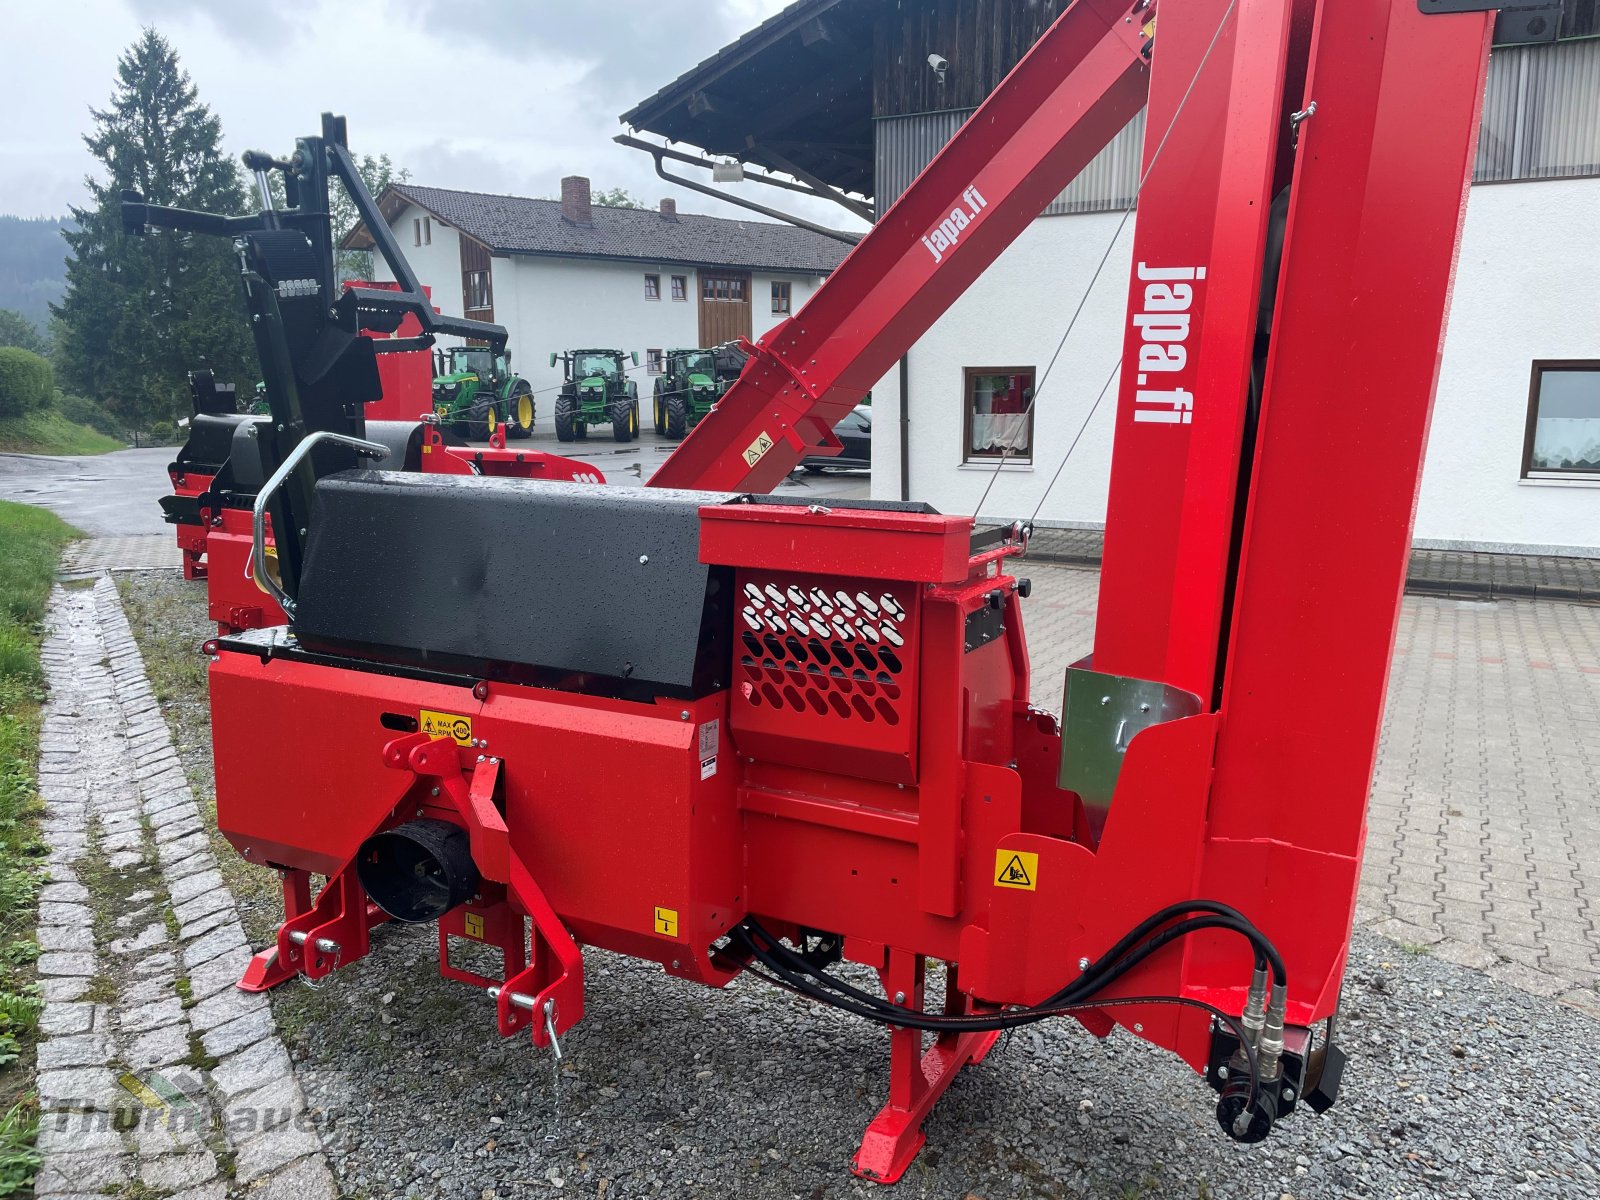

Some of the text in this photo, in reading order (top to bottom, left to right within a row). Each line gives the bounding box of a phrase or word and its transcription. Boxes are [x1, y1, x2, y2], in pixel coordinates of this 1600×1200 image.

[921, 184, 988, 264] japa.fi
[1133, 261, 1206, 424] japa.fi
[437, 720, 451, 728] MAX
[438, 729, 452, 737] RPM
